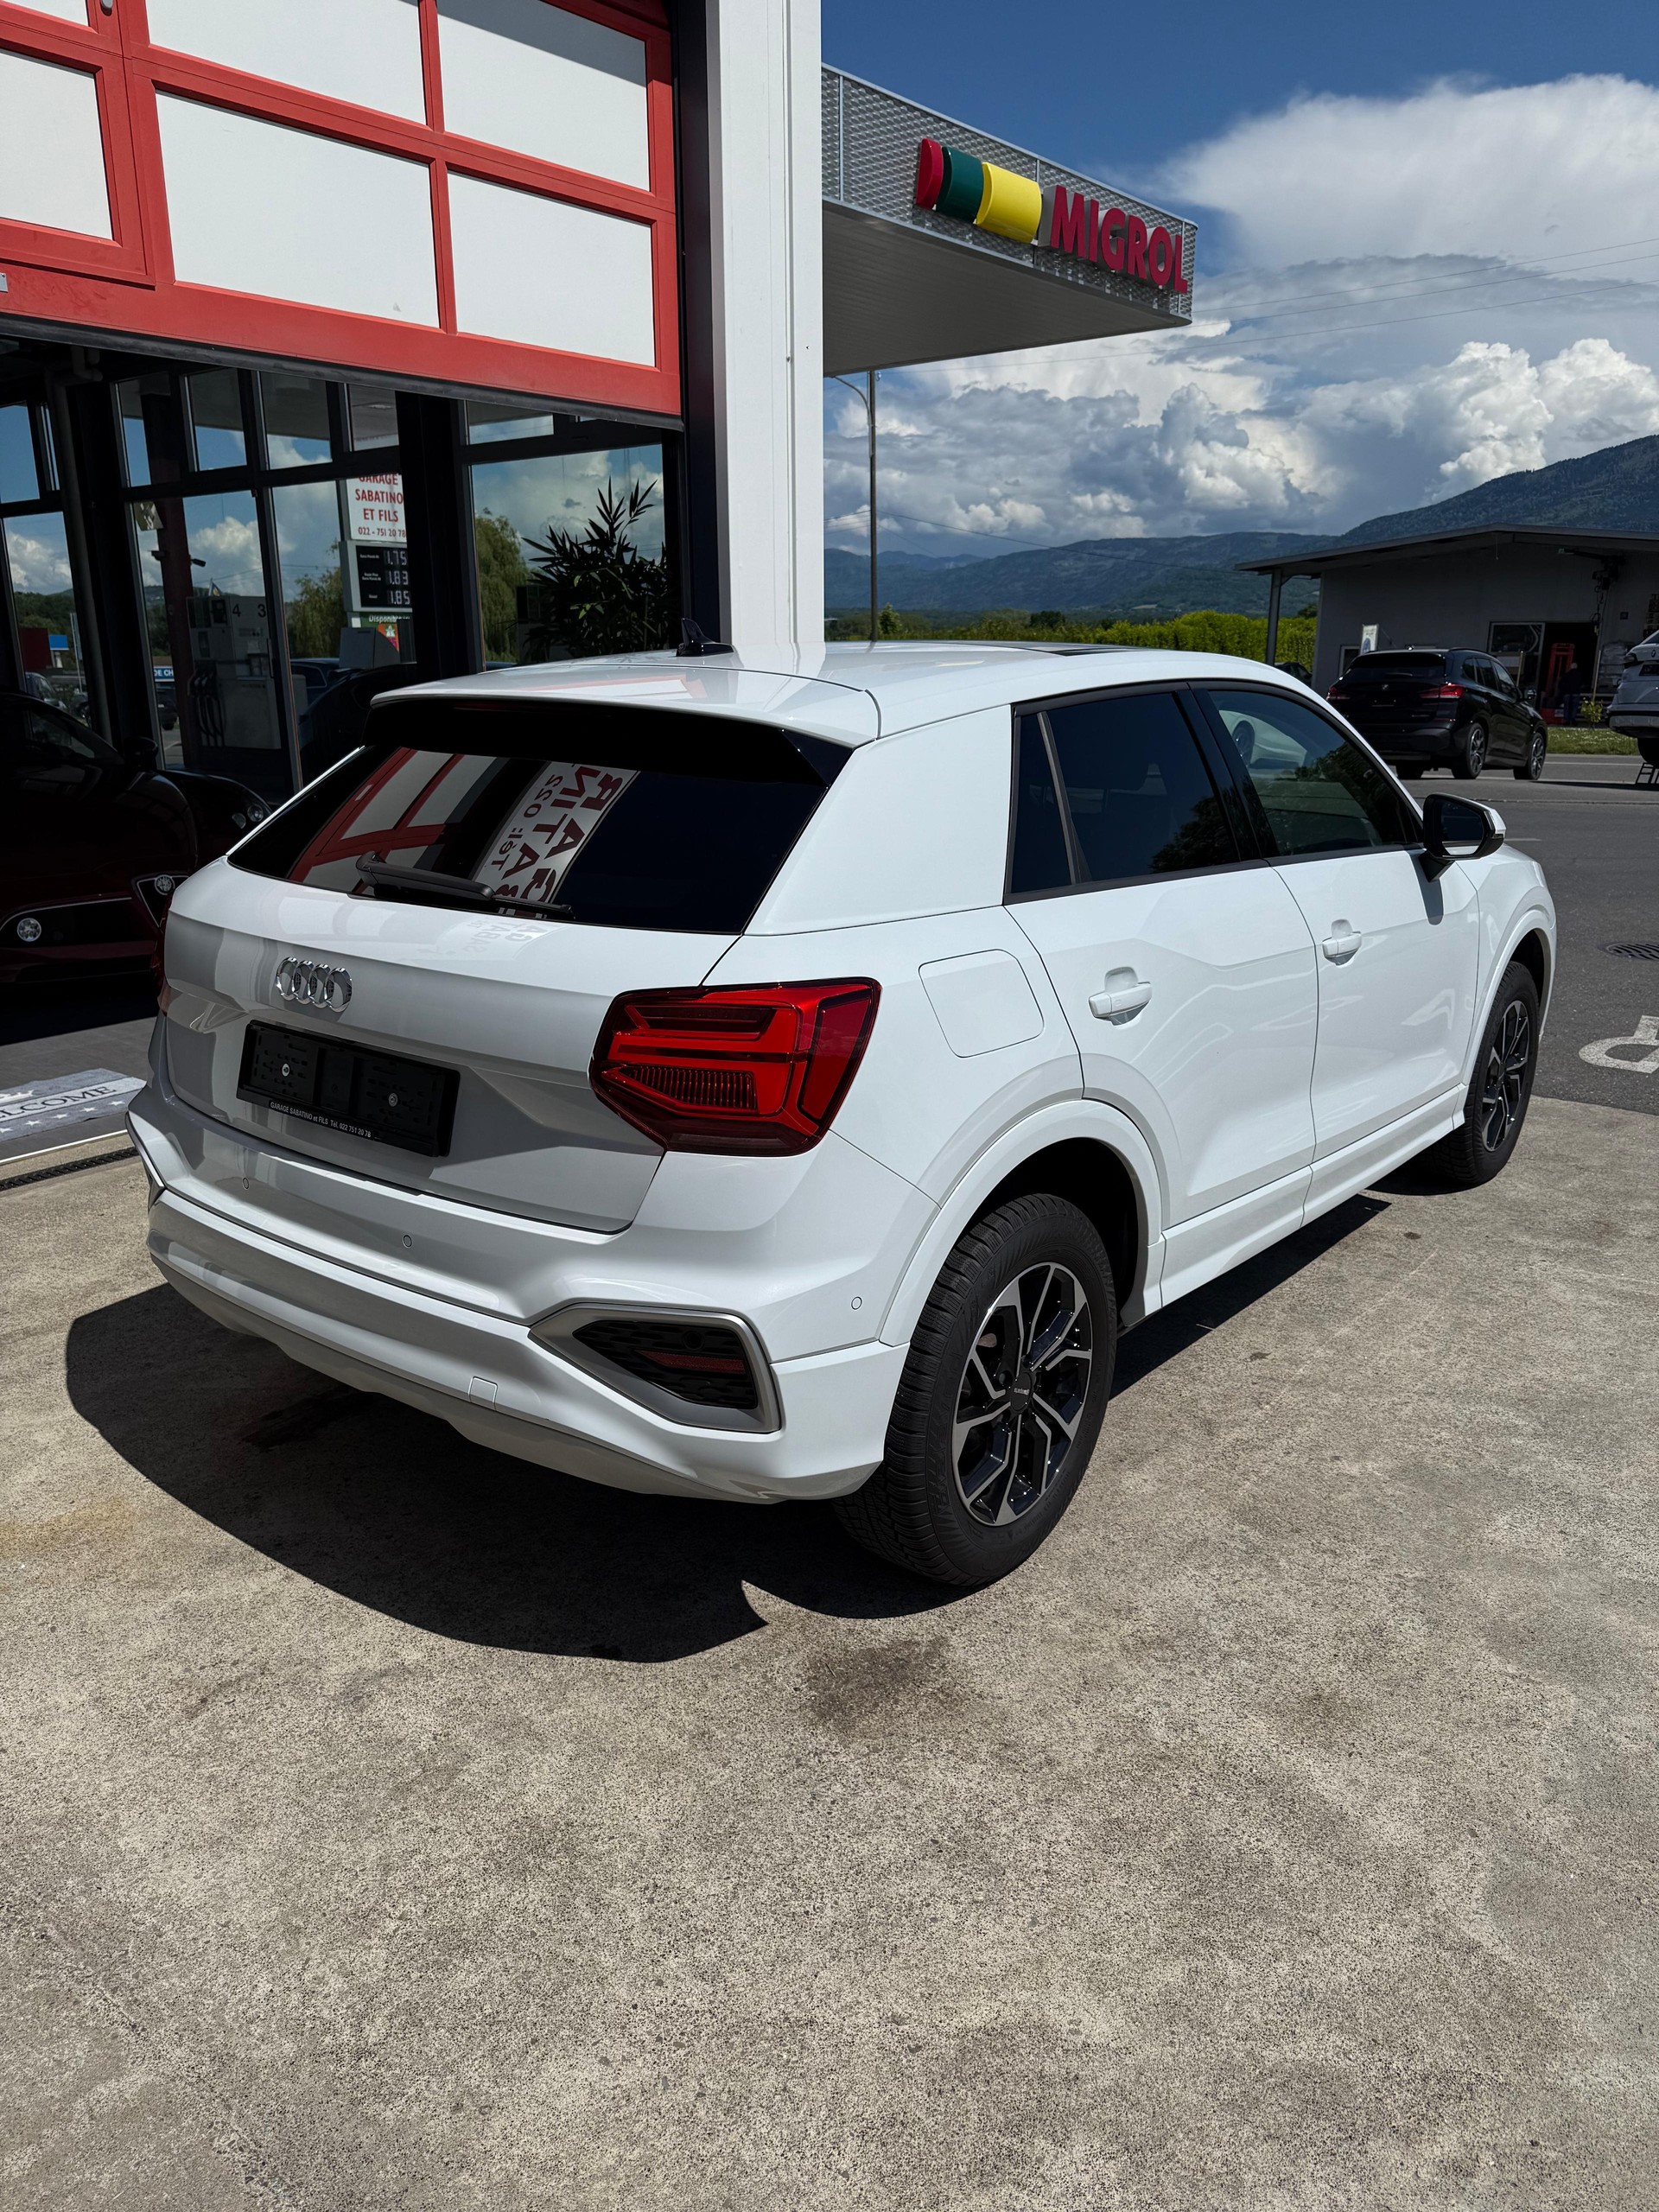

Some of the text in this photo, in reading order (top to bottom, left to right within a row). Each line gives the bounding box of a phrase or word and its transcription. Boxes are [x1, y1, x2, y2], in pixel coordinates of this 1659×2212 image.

[1046, 184, 1188, 294] MIGROL
[355, 488, 404, 505] SABATINO
[363, 508, 398, 523] ET FILS
[358, 526, 371, 536] 022
[377, 527, 387, 537] 751
[388, 529, 397, 537] 20
[386, 550, 407, 565] 1.75
[389, 570, 409, 585] 1.83
[391, 590, 410, 605] 1.85
[232, 604, 266, 618] 4 3
[0, 1086, 117, 1119] LCOME
[270, 1101, 289, 1113] GARAGE
[289, 1107, 312, 1120] SABATINO
[318, 1116, 328, 1125] FILS
[339, 1122, 348, 1131] 022
[348, 1125, 357, 1134] 751
[365, 1129, 372, 1138] 78
